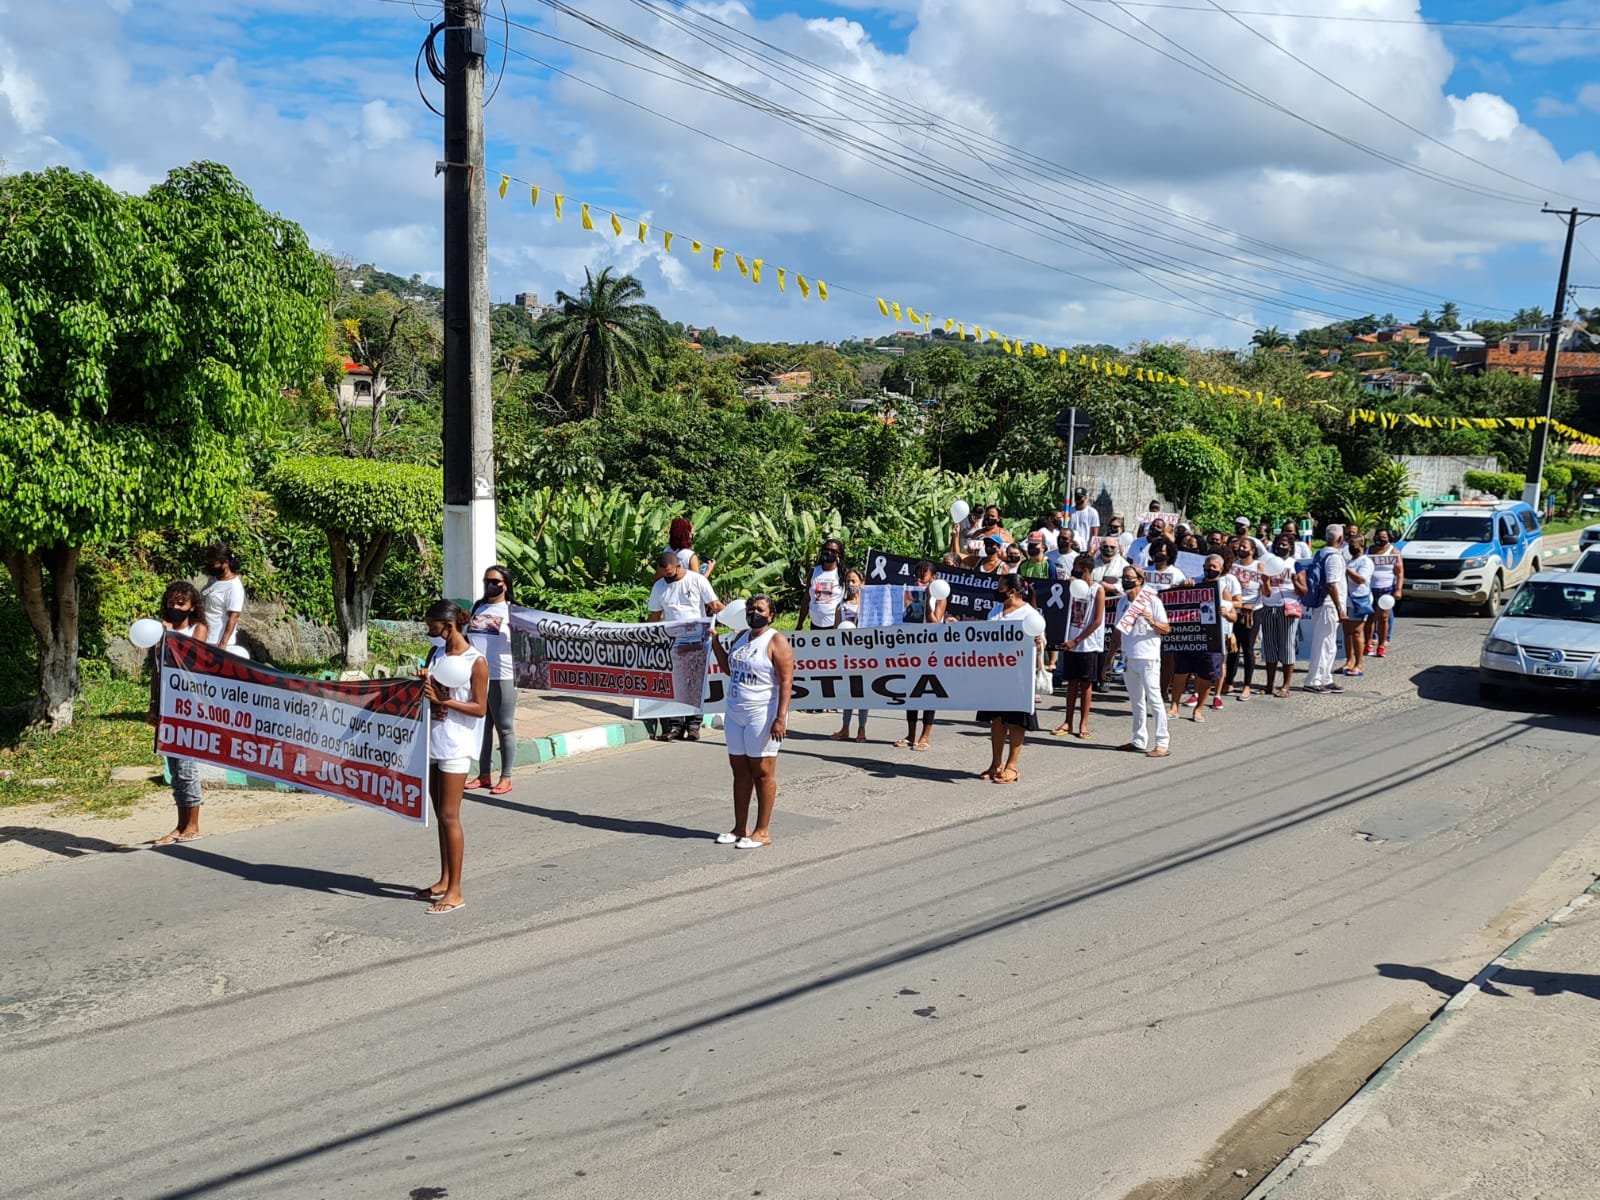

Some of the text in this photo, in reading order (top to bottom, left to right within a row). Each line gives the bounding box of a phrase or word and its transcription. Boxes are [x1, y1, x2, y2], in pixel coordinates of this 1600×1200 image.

[898, 563, 910, 576] A
[951, 594, 969, 607] na
[811, 636, 821, 647] e
[826, 635, 836, 646] a
[841, 628, 938, 650] Negligência
[944, 626, 961, 643] de
[965, 624, 1025, 642] Osvaldo
[1163, 643, 1208, 651] SALVADOR
[545, 639, 594, 664] NOSSO
[595, 641, 636, 668] GRITO
[843, 655, 879, 669] isso
[885, 652, 922, 668] não
[927, 651, 938, 667] é
[944, 649, 1024, 668] acidente"
[553, 668, 671, 694] INDENIZAÇÕES JÁ!
[169, 673, 415, 745] Quanto vale uma vida? A CL quer pagar
[175, 698, 405, 769] R$ 5.000,00 parcelado aos náufragos.
[159, 723, 420, 808] ONDE ESTÁ A JUSTIÇA?
